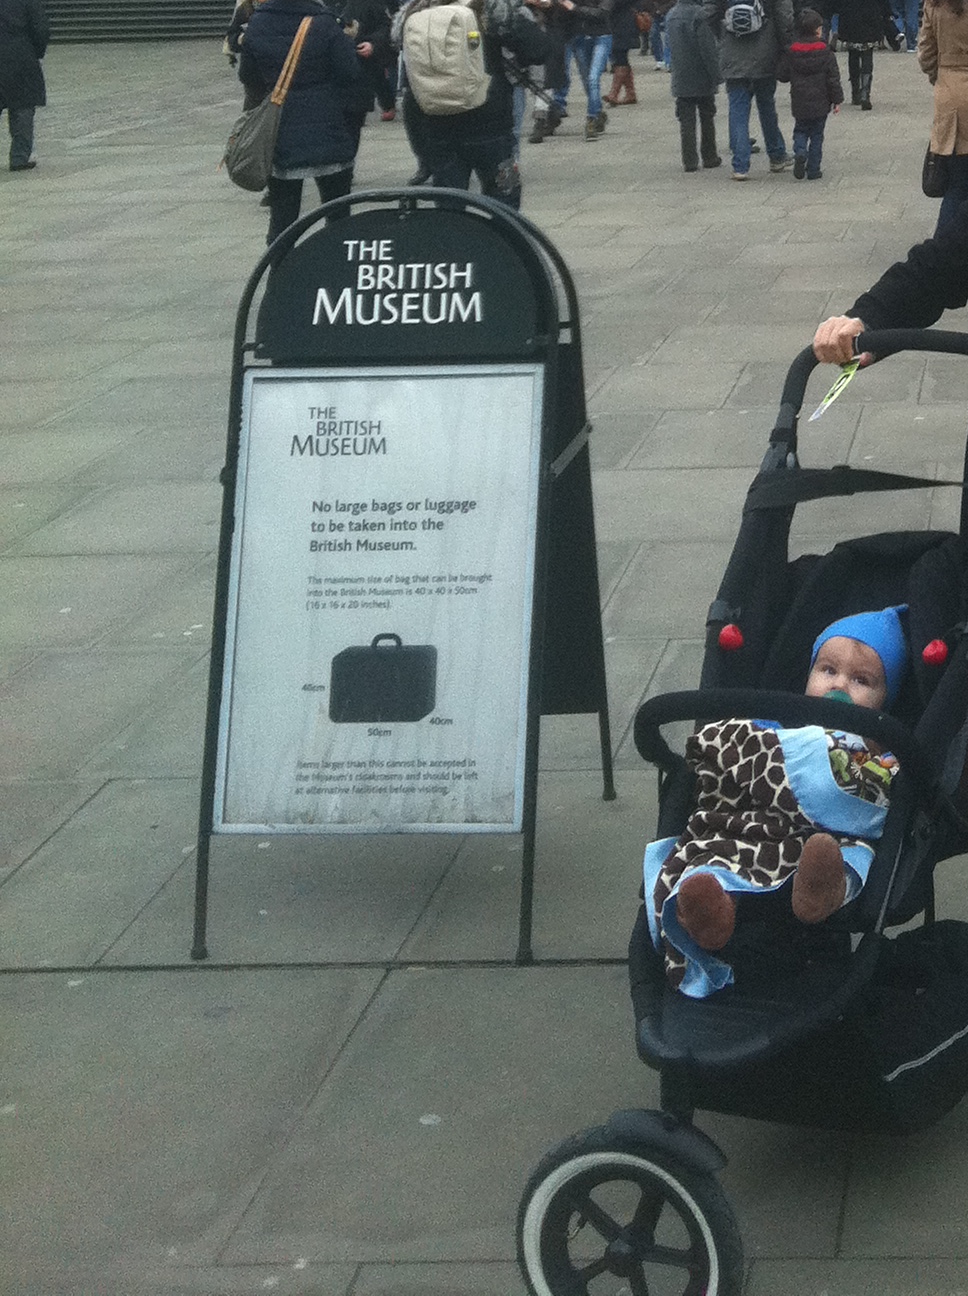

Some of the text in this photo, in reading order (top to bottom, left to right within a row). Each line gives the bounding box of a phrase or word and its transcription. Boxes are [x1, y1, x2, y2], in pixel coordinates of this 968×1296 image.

[343, 239, 394, 261] THE
[357, 262, 473, 290] BRITISH
[312, 287, 482, 325] MUSEUM
[308, 407, 336, 419] THE
[316, 420, 381, 436] BRITISH
[290, 435, 386, 456] MUSEUM
[312, 498, 477, 515] No large bags or luggage
[311, 518, 444, 532] to be taken into the
[310, 539, 417, 552] British Museum.
[429, 716, 453, 725] 40cm
[367, 727, 392, 737] 50cm
